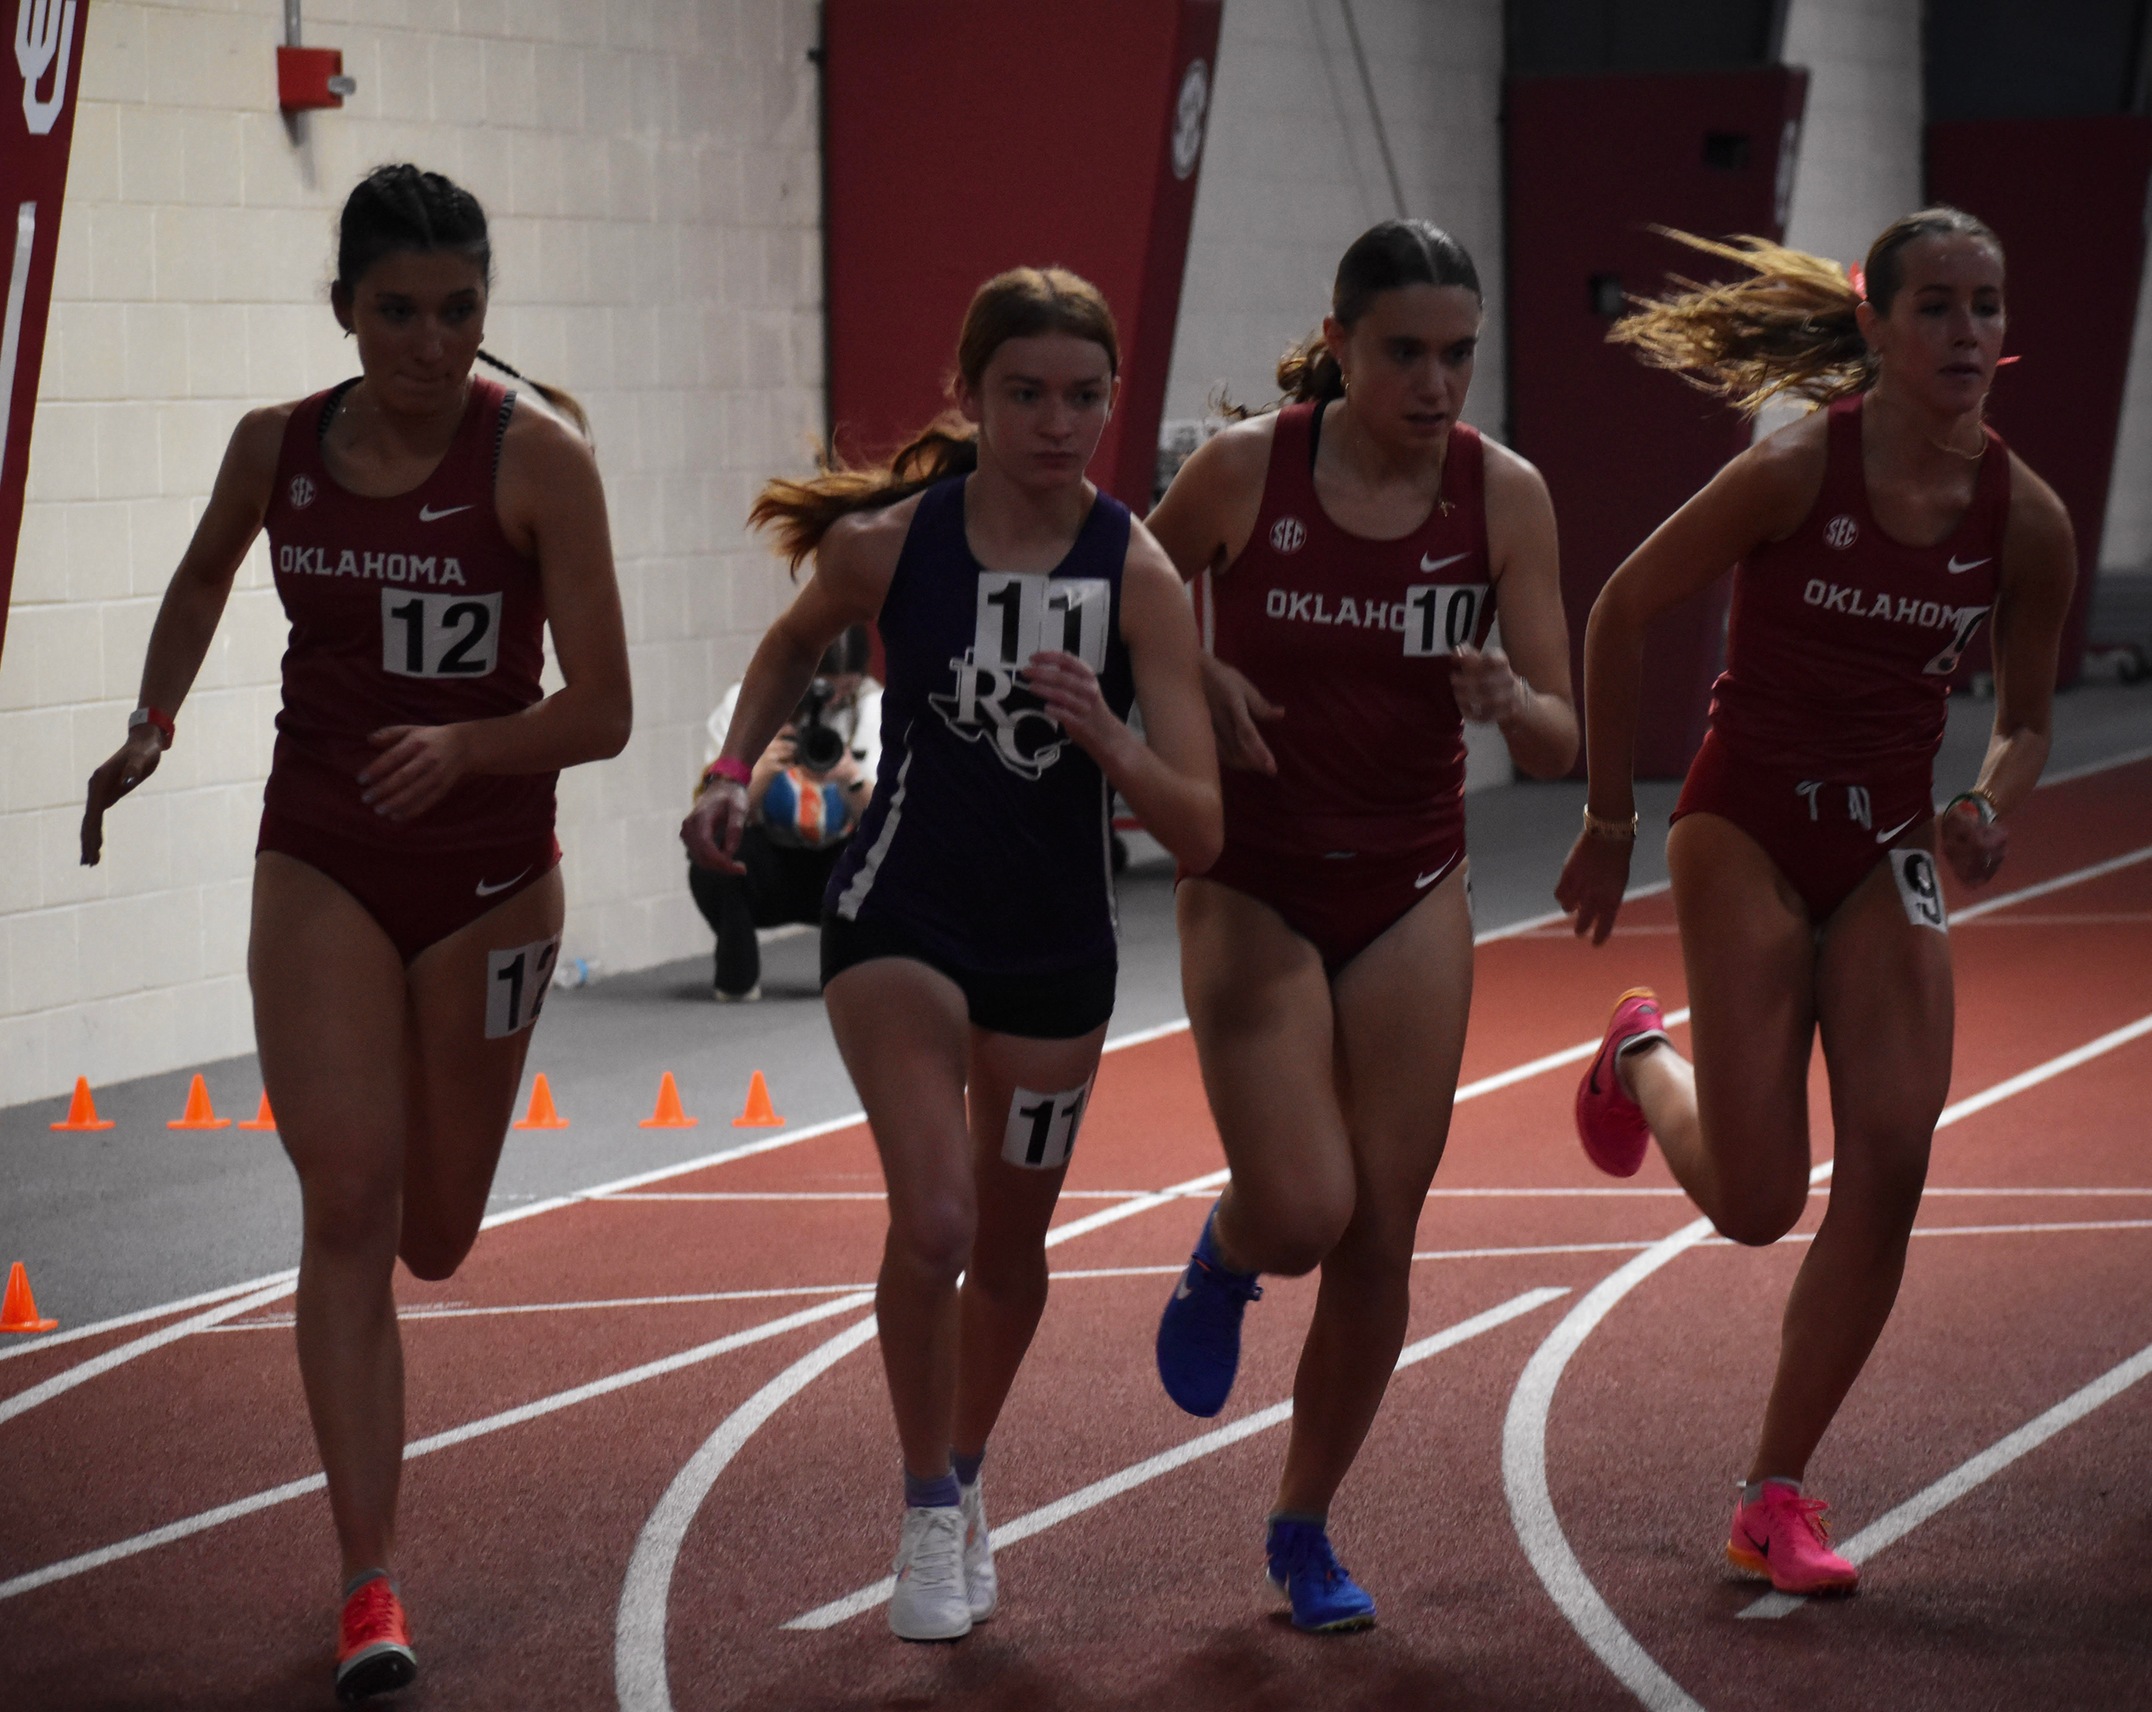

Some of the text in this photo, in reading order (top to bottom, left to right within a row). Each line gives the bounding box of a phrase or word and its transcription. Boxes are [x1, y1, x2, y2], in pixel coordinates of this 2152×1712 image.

[1271, 516, 1305, 552] SEC
[1825, 515, 1859, 548] SEC
[279, 545, 466, 586] OKLAHOMA
[987, 578, 1084, 664] 11
[1266, 588, 1406, 632] OKLAHO
[1412, 589, 1476, 651] 10
[1803, 578, 1961, 632] OKLAHOM
[391, 598, 490, 673] 12
[1904, 853, 1941, 925] 9
[1019, 1089, 1086, 1165] 11
